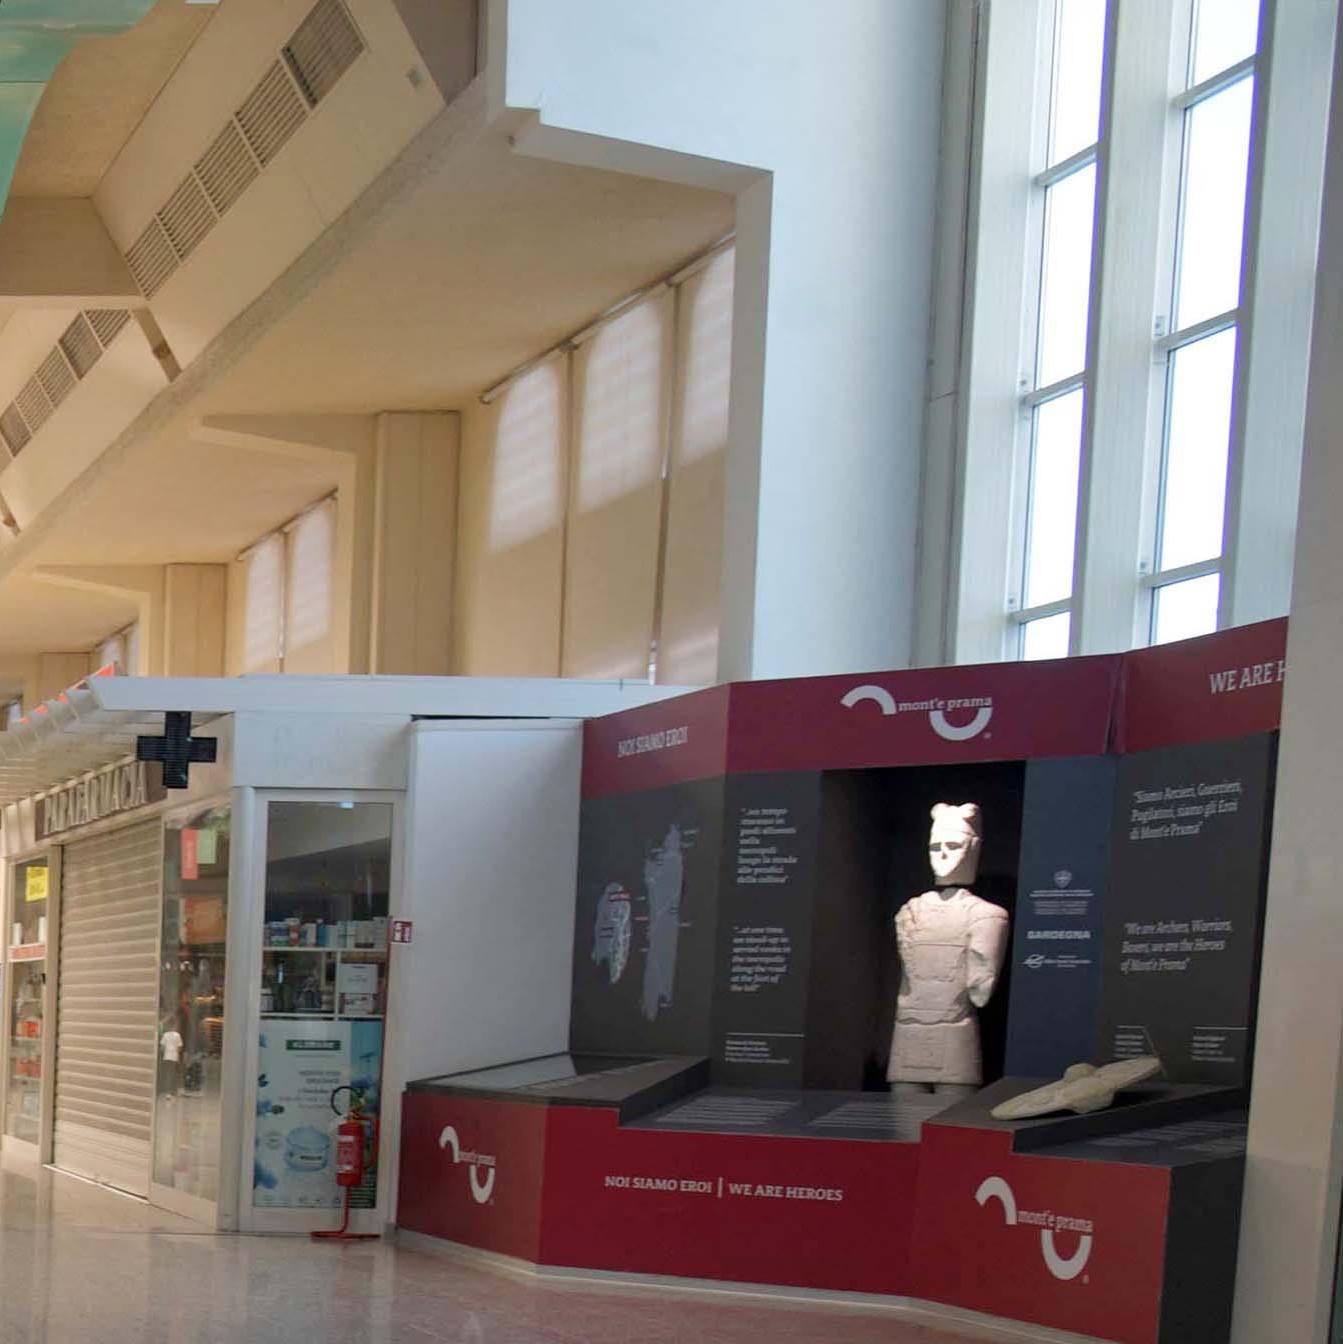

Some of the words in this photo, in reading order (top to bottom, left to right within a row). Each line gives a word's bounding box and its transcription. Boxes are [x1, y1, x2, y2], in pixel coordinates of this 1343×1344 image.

[1209, 670, 1238, 695] WE
[1239, 662, 1273, 689] ARE
[947, 696, 993, 712] prama
[1026, 929, 1092, 940] SARDEGNA
[604, 1175, 630, 1188] NOI
[632, 1177, 678, 1191] SIAMO
[680, 1180, 713, 1194] EROI
[728, 1182, 752, 1196] WE
[754, 1184, 784, 1198] ARE
[785, 1186, 843, 1202] HEROES
[1055, 1215, 1093, 1233] prama
